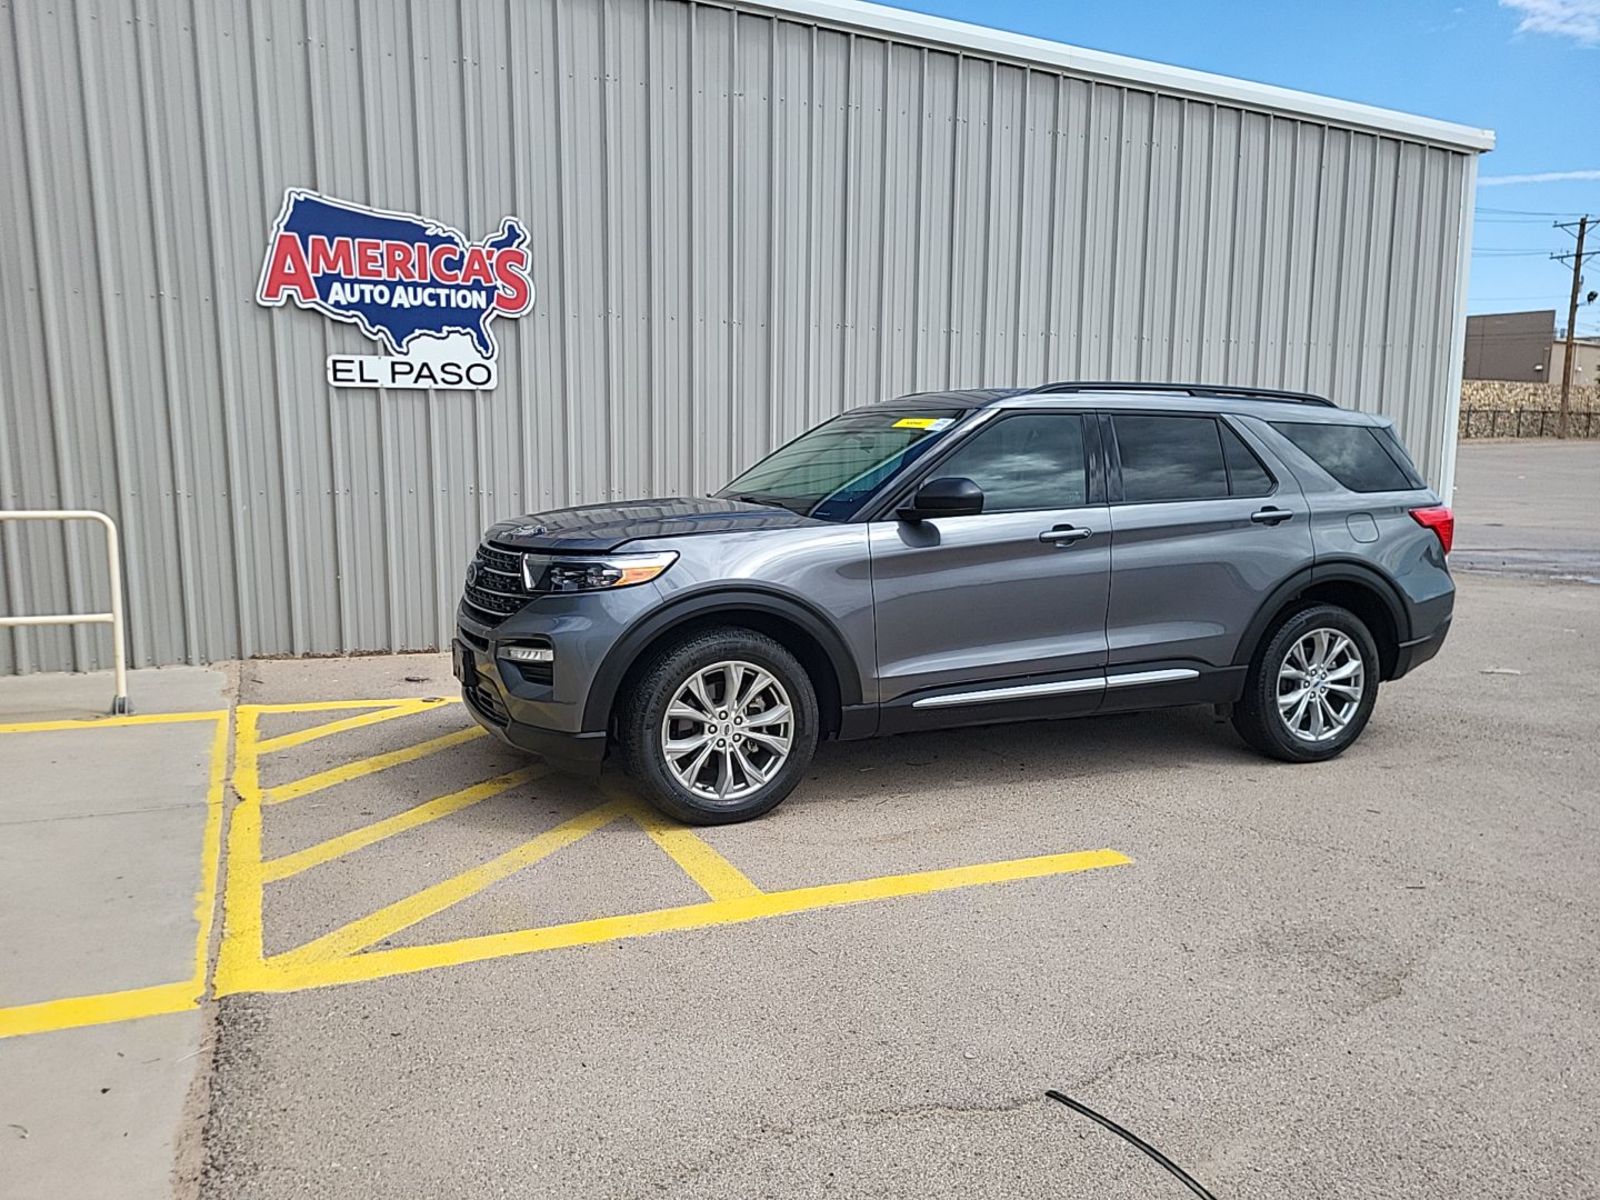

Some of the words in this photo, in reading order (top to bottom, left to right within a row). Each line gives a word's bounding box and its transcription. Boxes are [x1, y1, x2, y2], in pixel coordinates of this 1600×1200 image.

[263, 232, 530, 312] AMERICA'S
[328, 282, 391, 305] AUTO
[391, 286, 488, 310] AUCTION
[331, 359, 379, 383] EL
[390, 361, 492, 386] PASO
